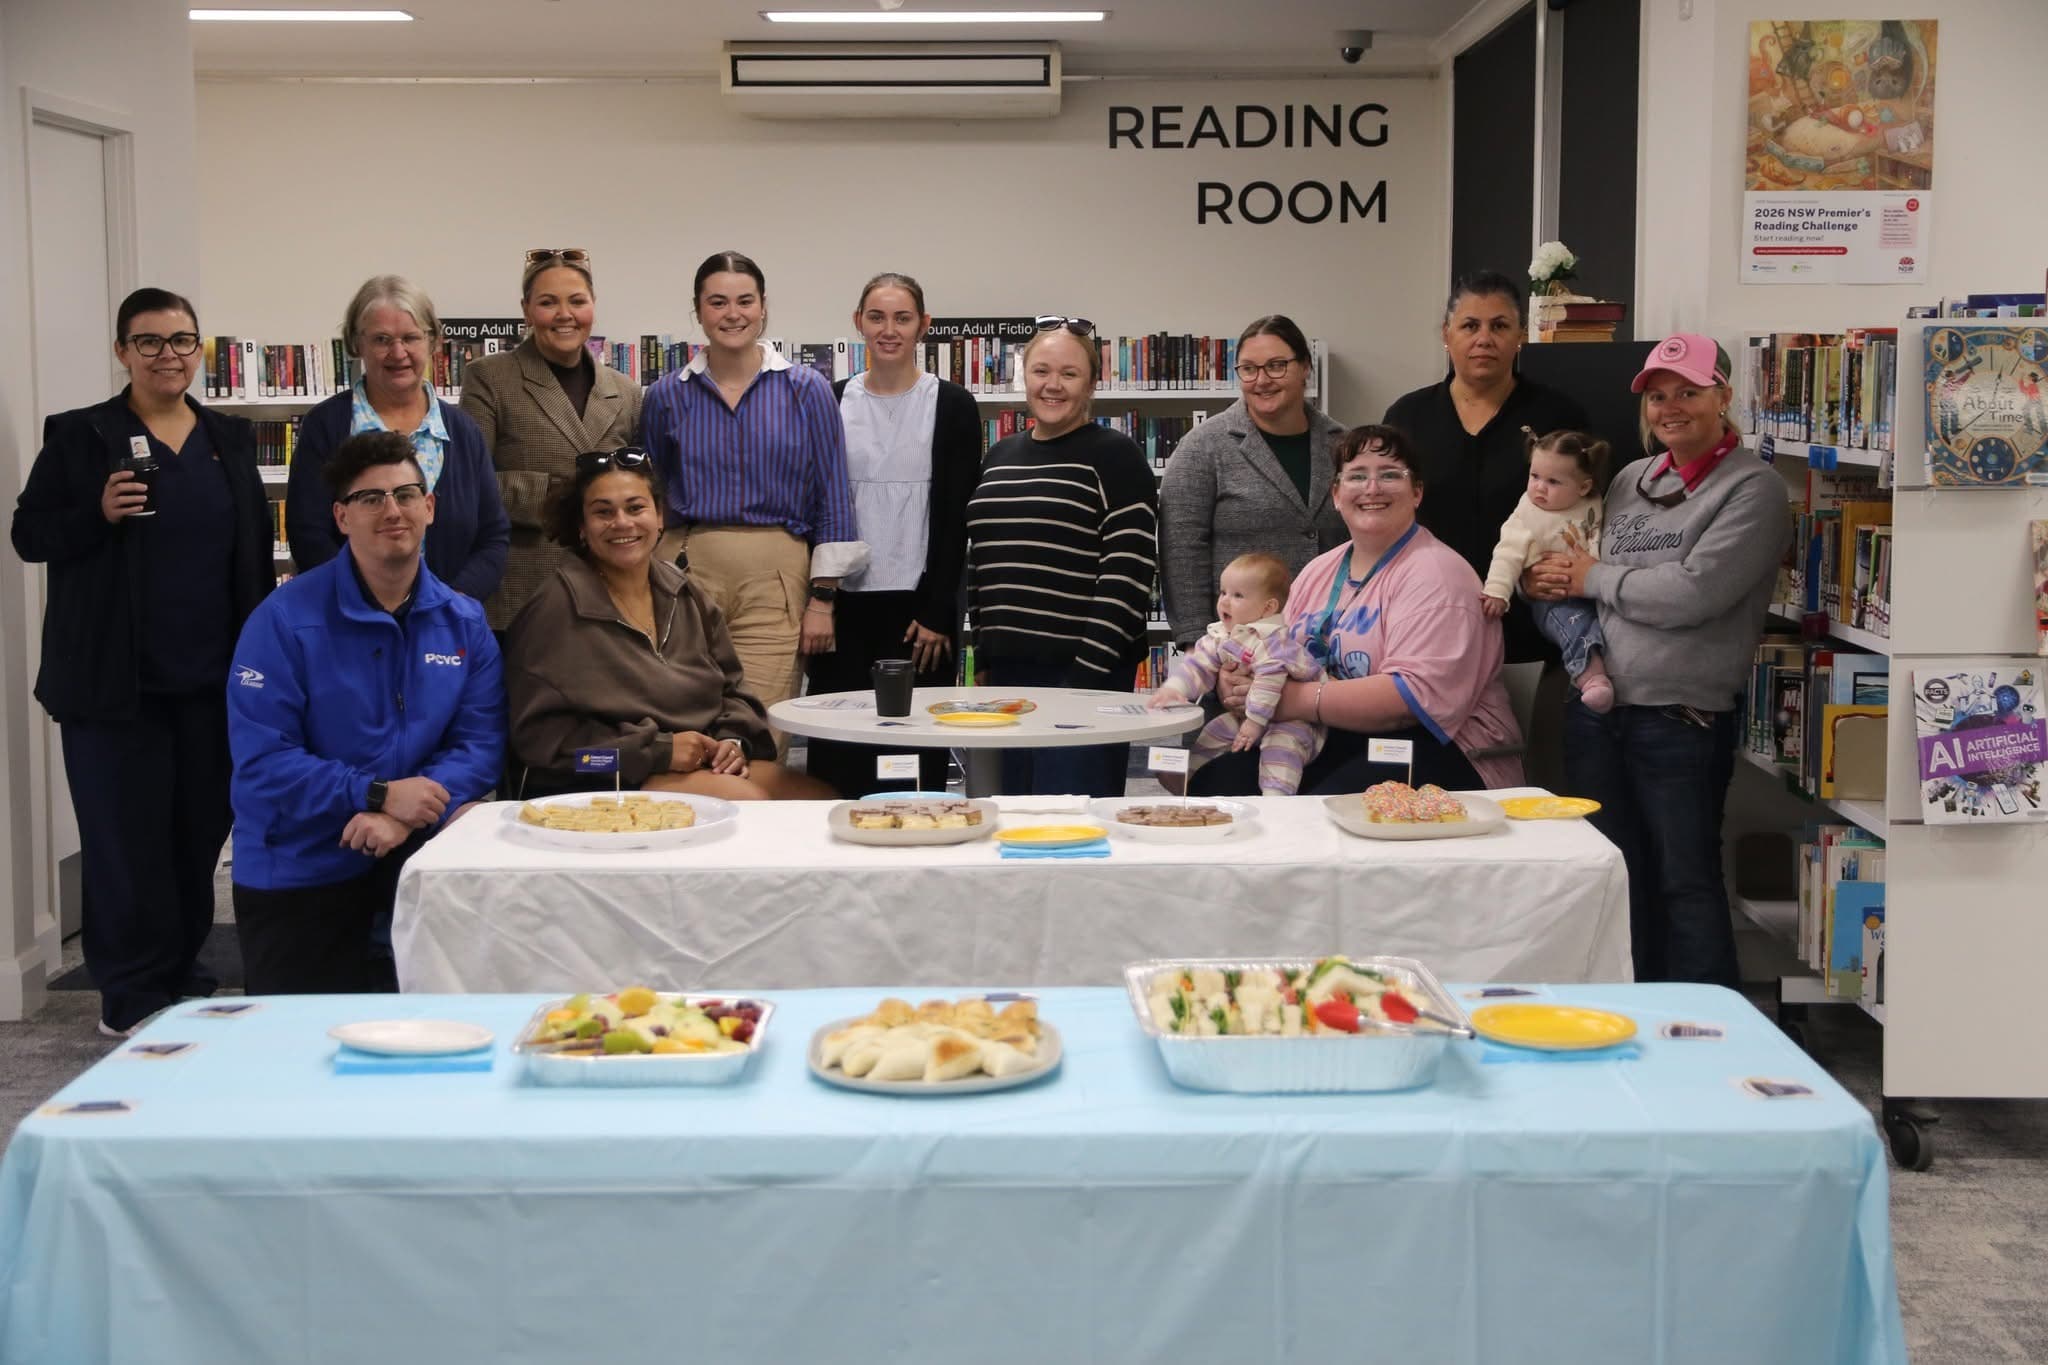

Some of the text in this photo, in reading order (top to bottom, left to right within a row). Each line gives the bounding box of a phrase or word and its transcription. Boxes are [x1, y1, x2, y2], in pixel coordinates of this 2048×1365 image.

[1108, 103, 1389, 149] READING
[1197, 180, 1387, 224] ROOM
[1754, 208, 1871, 218] 2026 NSW Premier's
[1754, 220, 1858, 232] Reading Challenge
[1775, 235, 1805, 243] reading
[480, 323, 513, 336] Adult
[961, 322, 994, 335] Adult
[999, 322, 1033, 335] Fictio
[246, 342, 253, 353] B
[488, 342, 496, 353] G
[1989, 410, 2024, 423] Time
[1610, 528, 1684, 555] Williams
[425, 655, 462, 666] PCYC
[1966, 731, 2038, 751] ARTIFICIAL
[1929, 738, 1965, 773] AI
[1967, 743, 2040, 762] INTELLIGENCE
